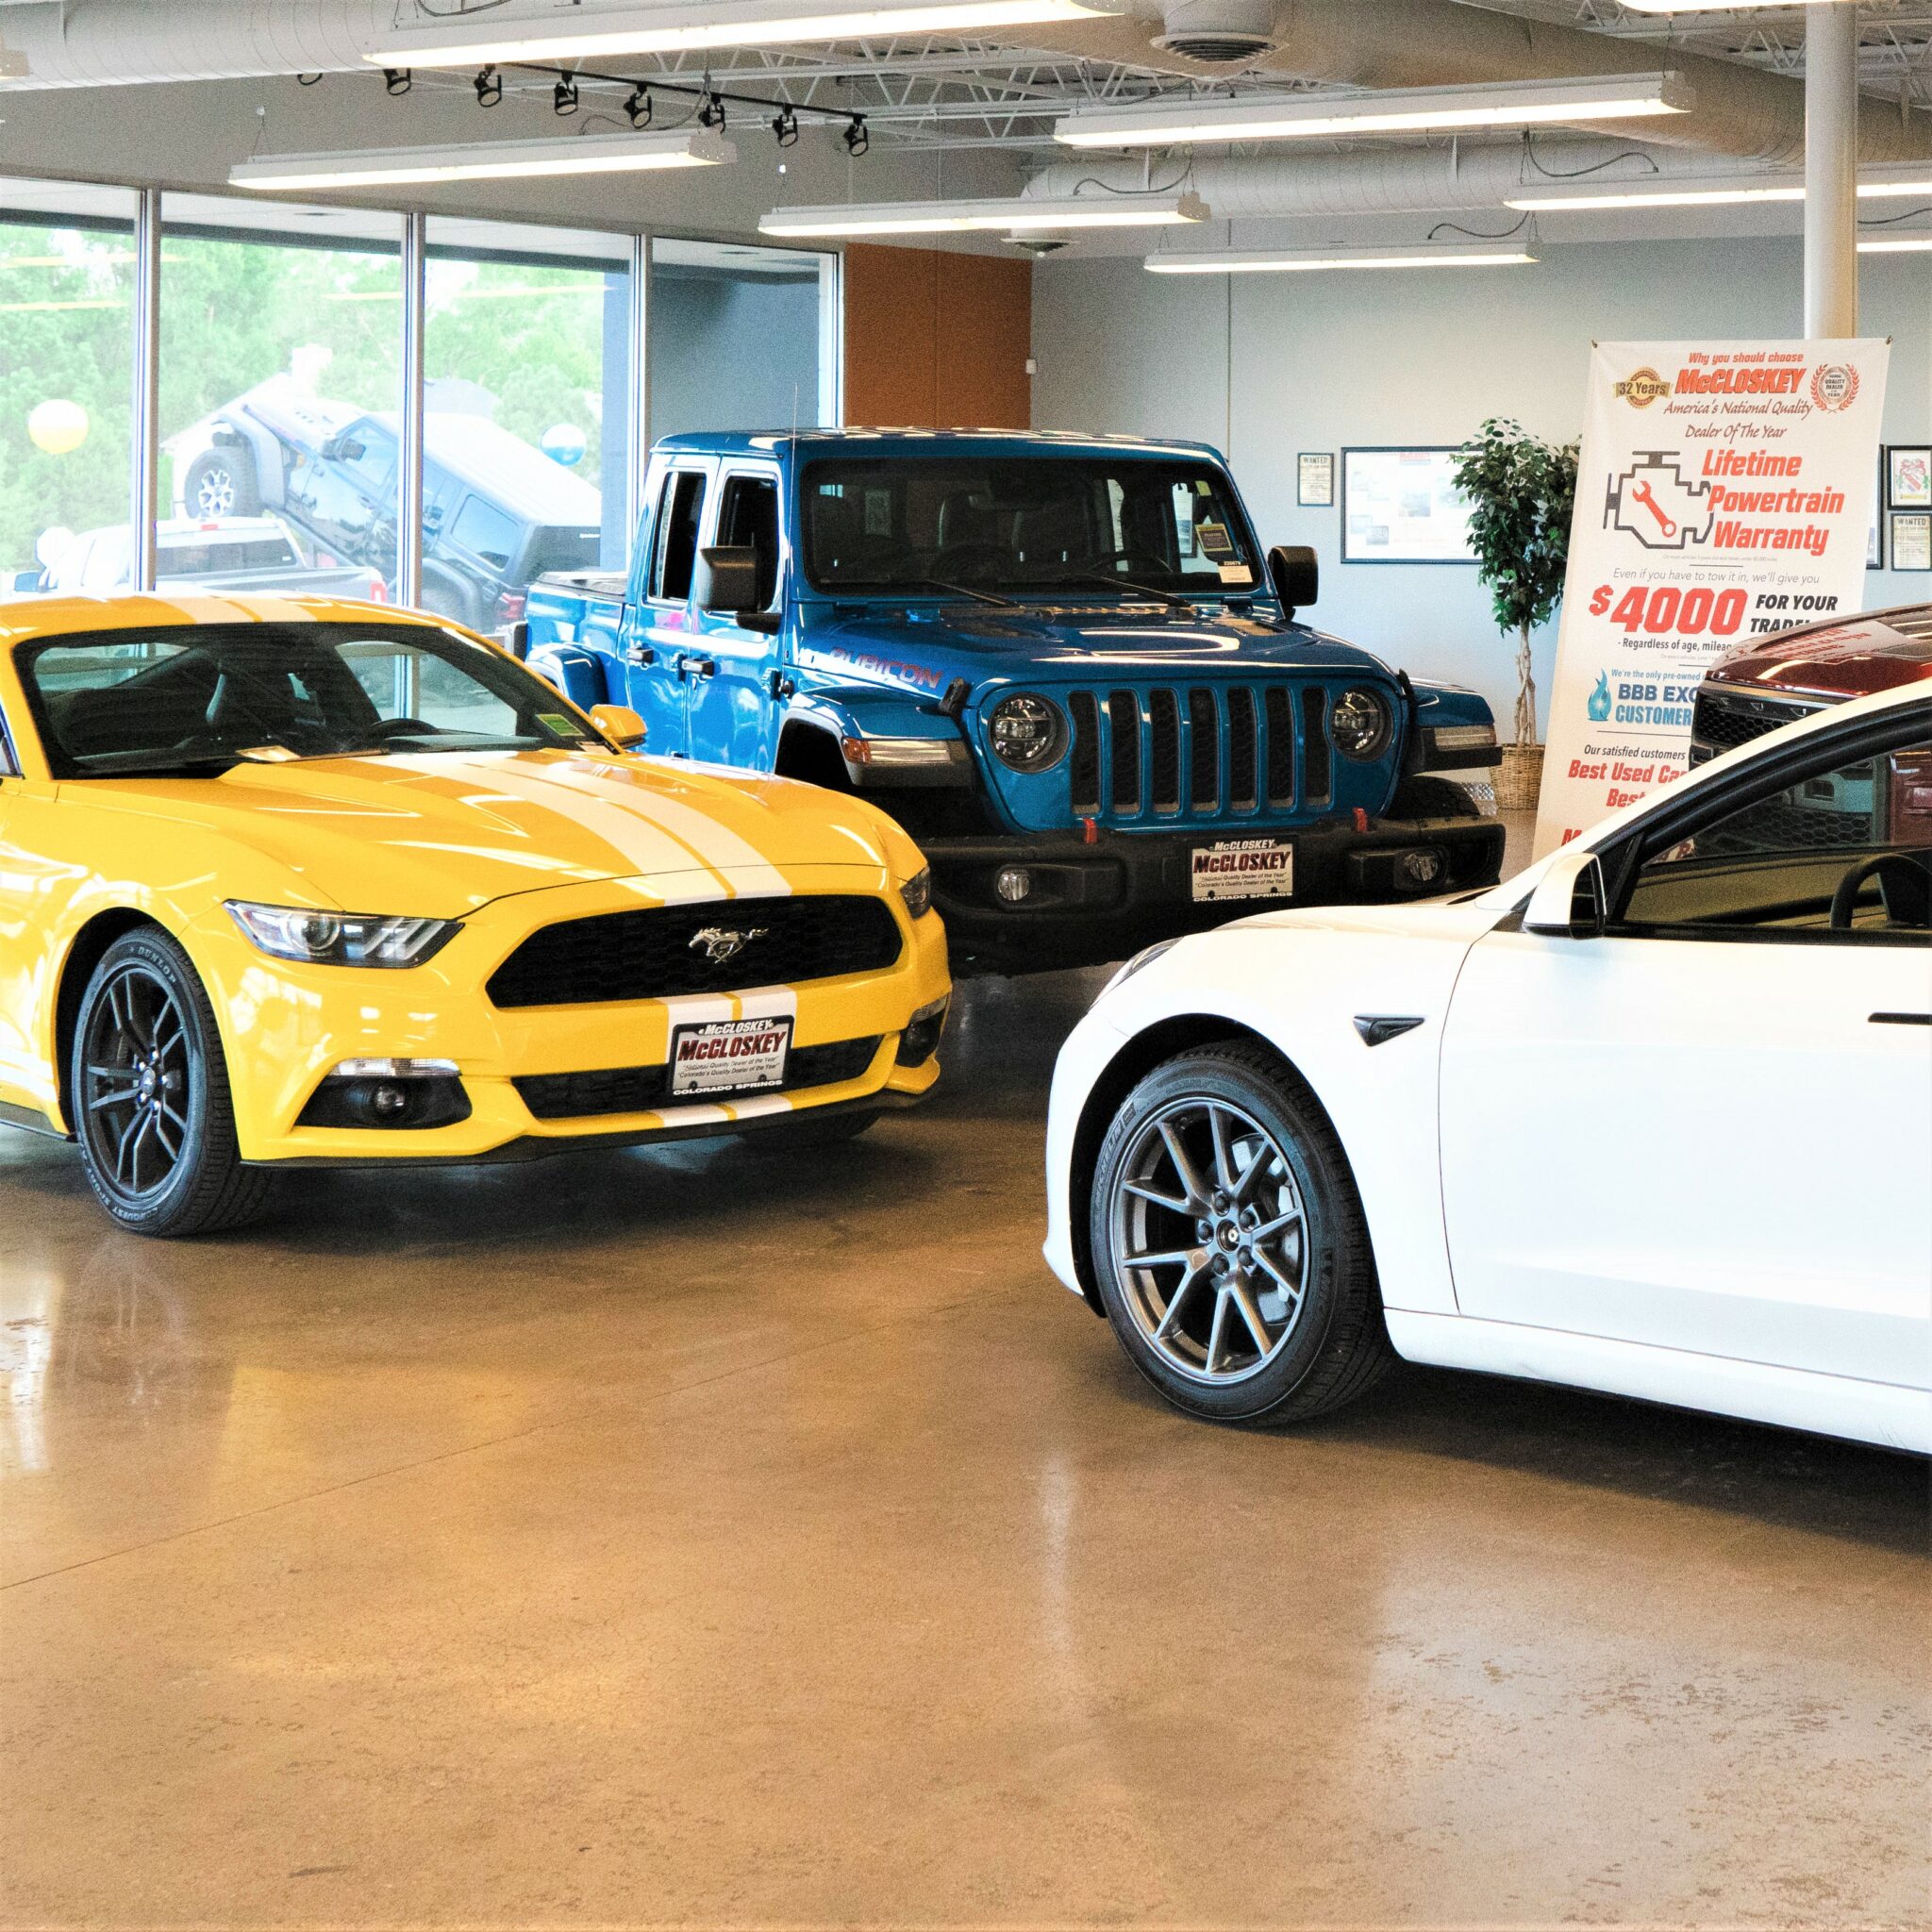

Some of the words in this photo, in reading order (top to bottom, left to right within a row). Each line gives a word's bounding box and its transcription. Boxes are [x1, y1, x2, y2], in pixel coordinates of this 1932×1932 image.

[1689, 353, 1709, 365] Why
[1712, 355, 1730, 365] you
[1733, 352, 1766, 363] should
[1768, 352, 1804, 363] choose
[1619, 382, 1633, 395] 32
[1636, 382, 1666, 395] Years
[1674, 368, 1807, 394] McCLOSKEY
[1663, 398, 1718, 415] America's
[1720, 398, 1773, 414] National
[1772, 398, 1813, 421] Quality
[1685, 423, 1723, 438] Dealer
[1723, 422, 1741, 444] Of
[1740, 423, 1760, 439] The
[1761, 425, 1788, 439] Year
[1701, 449, 1803, 476] Lifetime
[1707, 485, 1845, 513] Powertrain
[1896, 517, 1926, 525] WANTED
[1713, 521, 1829, 557] Warranty
[1613, 567, 1637, 578] Even
[1639, 568, 1648, 578] if
[1647, 570, 1667, 583] you
[1669, 569, 1692, 581] have
[1693, 571, 1706, 581] to
[1707, 571, 1727, 581] tow
[1728, 572, 1736, 582] it
[1738, 572, 1749, 584] in,
[1752, 572, 1775, 583] we'll
[1777, 573, 1799, 586] give
[1802, 575, 1820, 586] you
[1589, 585, 1749, 636] $4000
[1756, 593, 1790, 609] FOR
[1792, 595, 1839, 611] YOUR
[1750, 618, 1810, 633] TRAD
[1623, 638, 1669, 651] Regardless
[1671, 639, 1681, 649] of
[1683, 641, 1700, 653] age,
[830, 646, 943, 690] RUBICON
[1611, 669, 1631, 678] We're
[1632, 669, 1644, 678] the
[1646, 671, 1661, 682] only
[1663, 671, 1701, 681] pre-owned
[1618, 683, 1657, 701] BBB
[1585, 744, 1601, 756] Our
[1602, 745, 1641, 758] satisfied
[1641, 748, 1686, 760] customers
[1568, 758, 1607, 780] Best
[1611, 761, 1656, 783] Used
[1214, 839, 1275, 851] McCLOSKEY
[1193, 851, 1291, 874] McCLOSKEY
[1193, 894, 1247, 903] COLORADO
[137, 946, 176, 983] DUNLOP
[705, 1019, 772, 1035] McCLOSKEY
[677, 1031, 787, 1062] McCLOSKEY
[711, 1068, 731, 1076] Quality
[673, 1085, 733, 1095] COLORADO
[735, 1079, 783, 1090] SPRINGS
